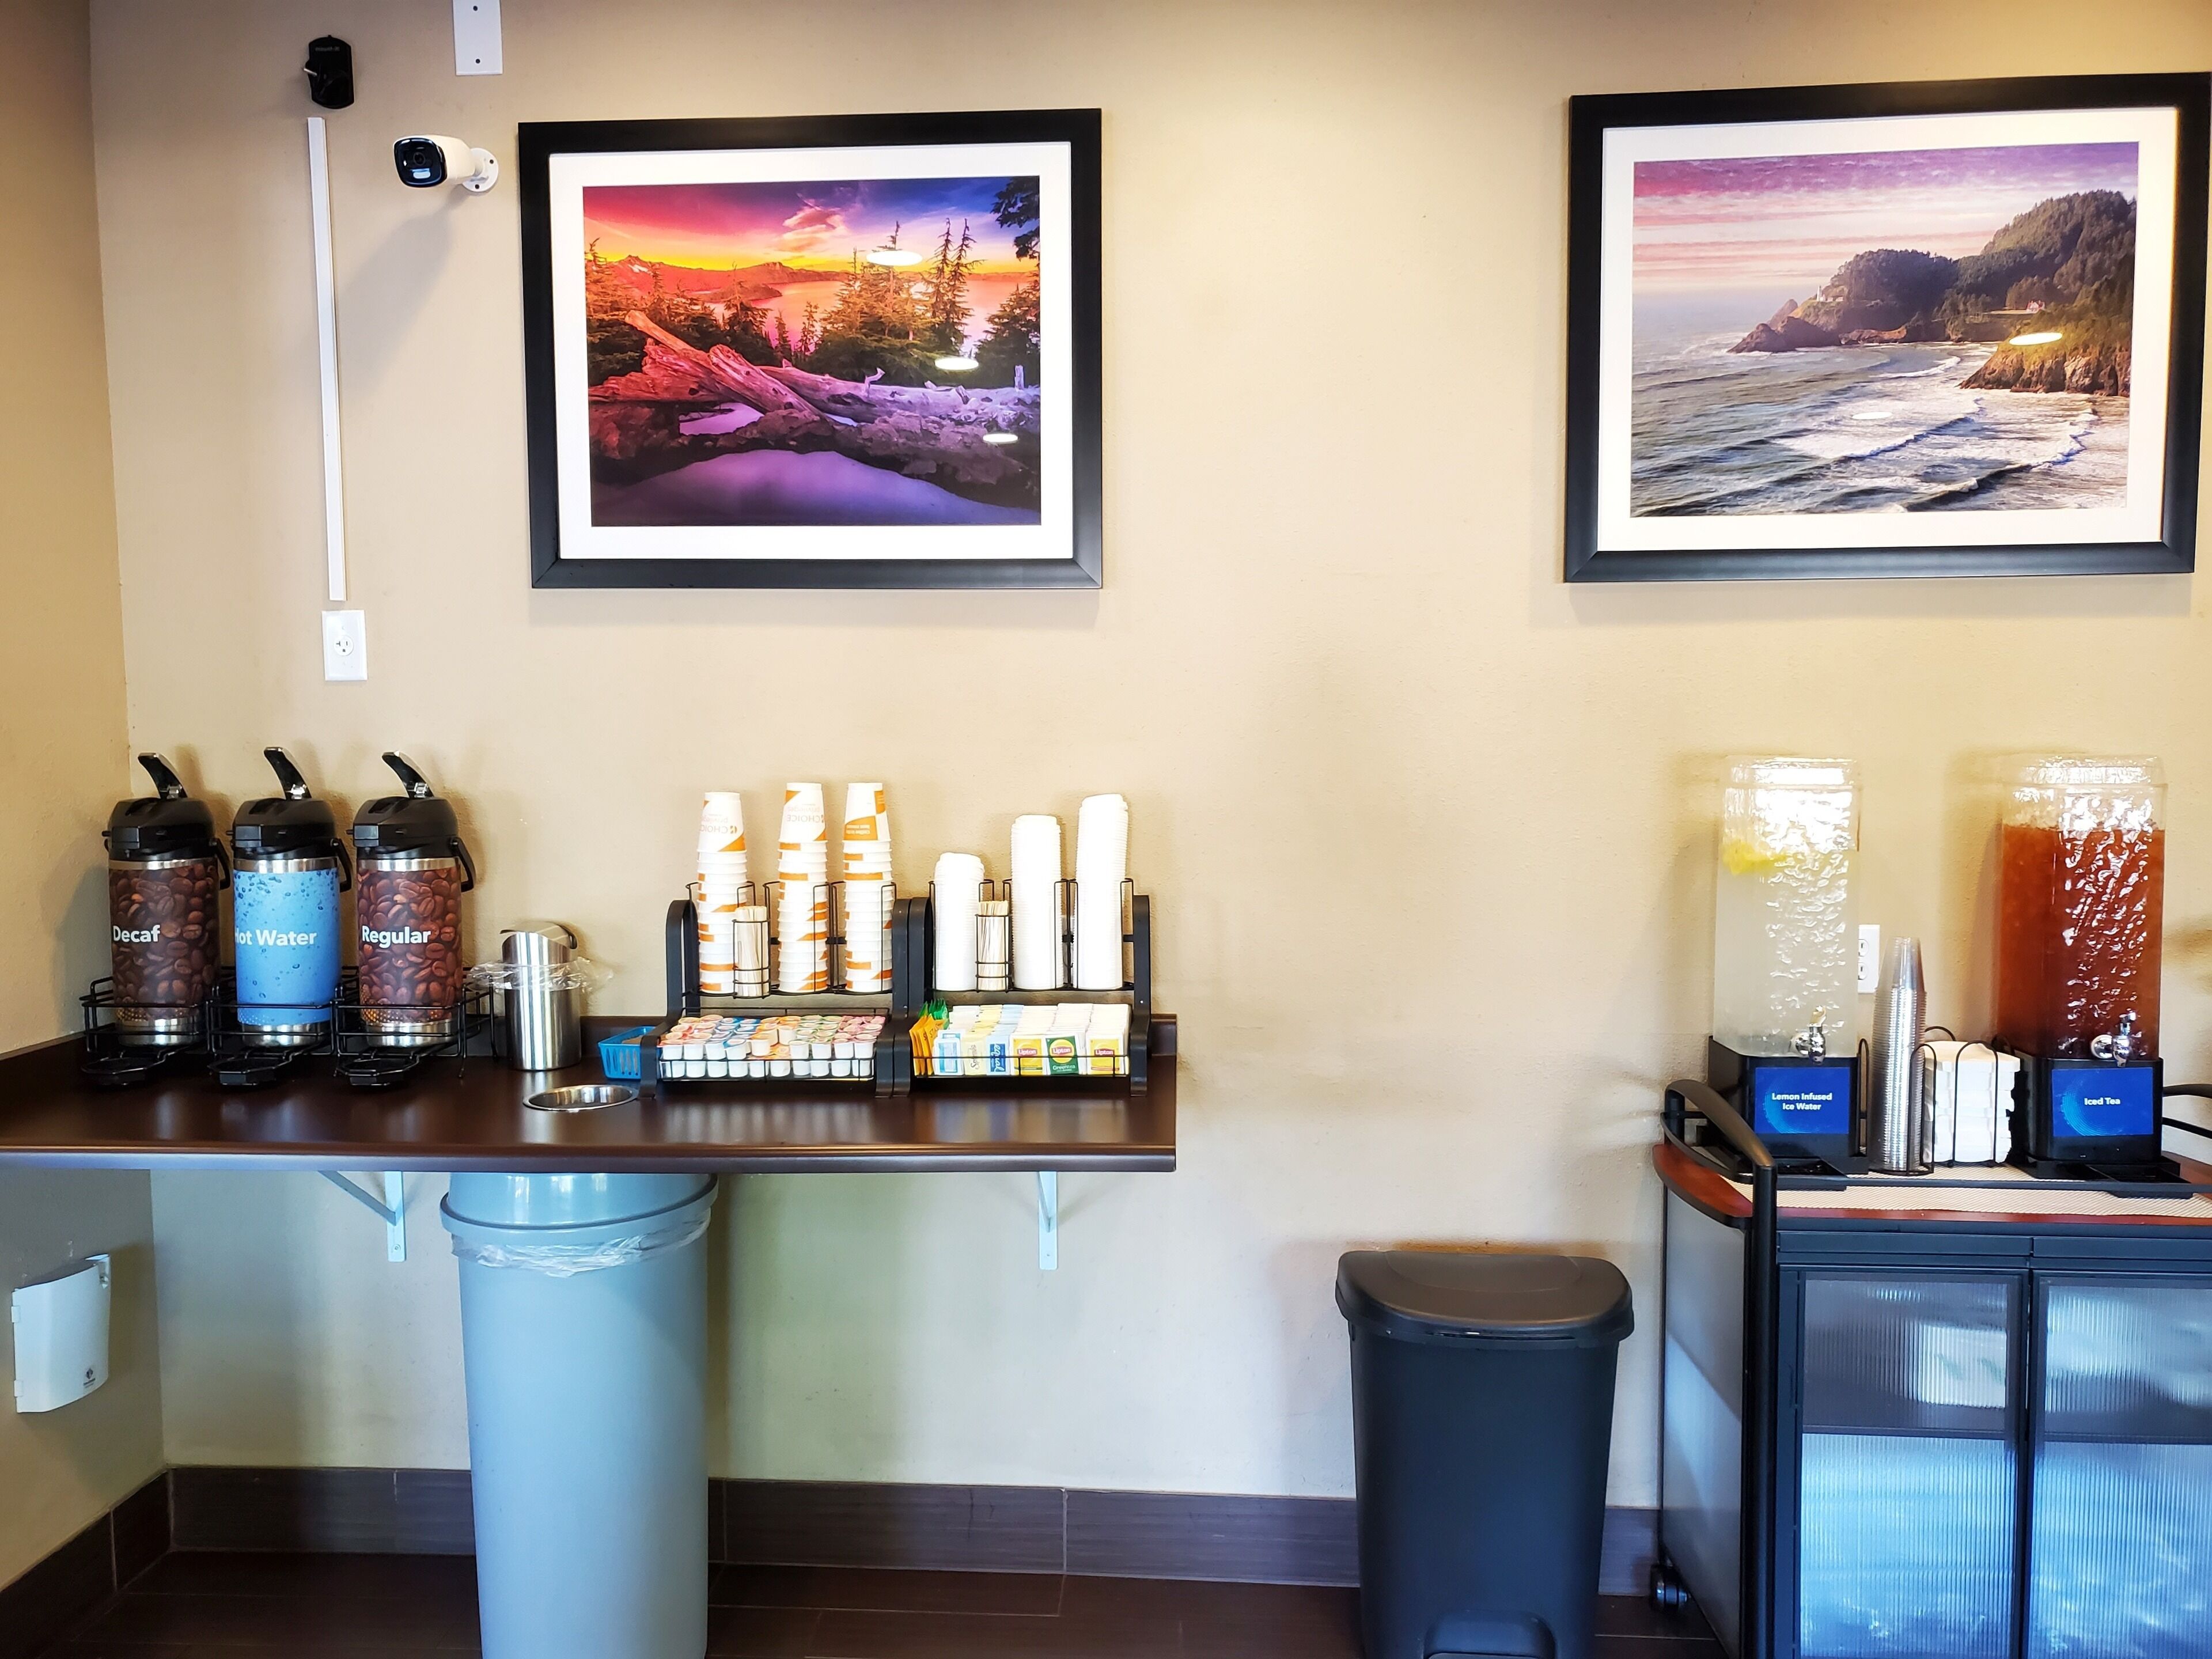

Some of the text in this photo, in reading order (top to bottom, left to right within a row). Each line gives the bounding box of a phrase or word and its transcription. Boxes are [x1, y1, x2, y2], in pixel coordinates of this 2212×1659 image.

[787, 815, 820, 823] CHOICE
[700, 824, 729, 834] CHOIC
[113, 924, 160, 942] Decaf
[255, 929, 317, 946] Water
[362, 925, 431, 949] Regular
[1052, 1047, 1071, 1055] Lipton
[1801, 1092, 1832, 1100] Infused
[2084, 1097, 2120, 1105] Iced Tea
